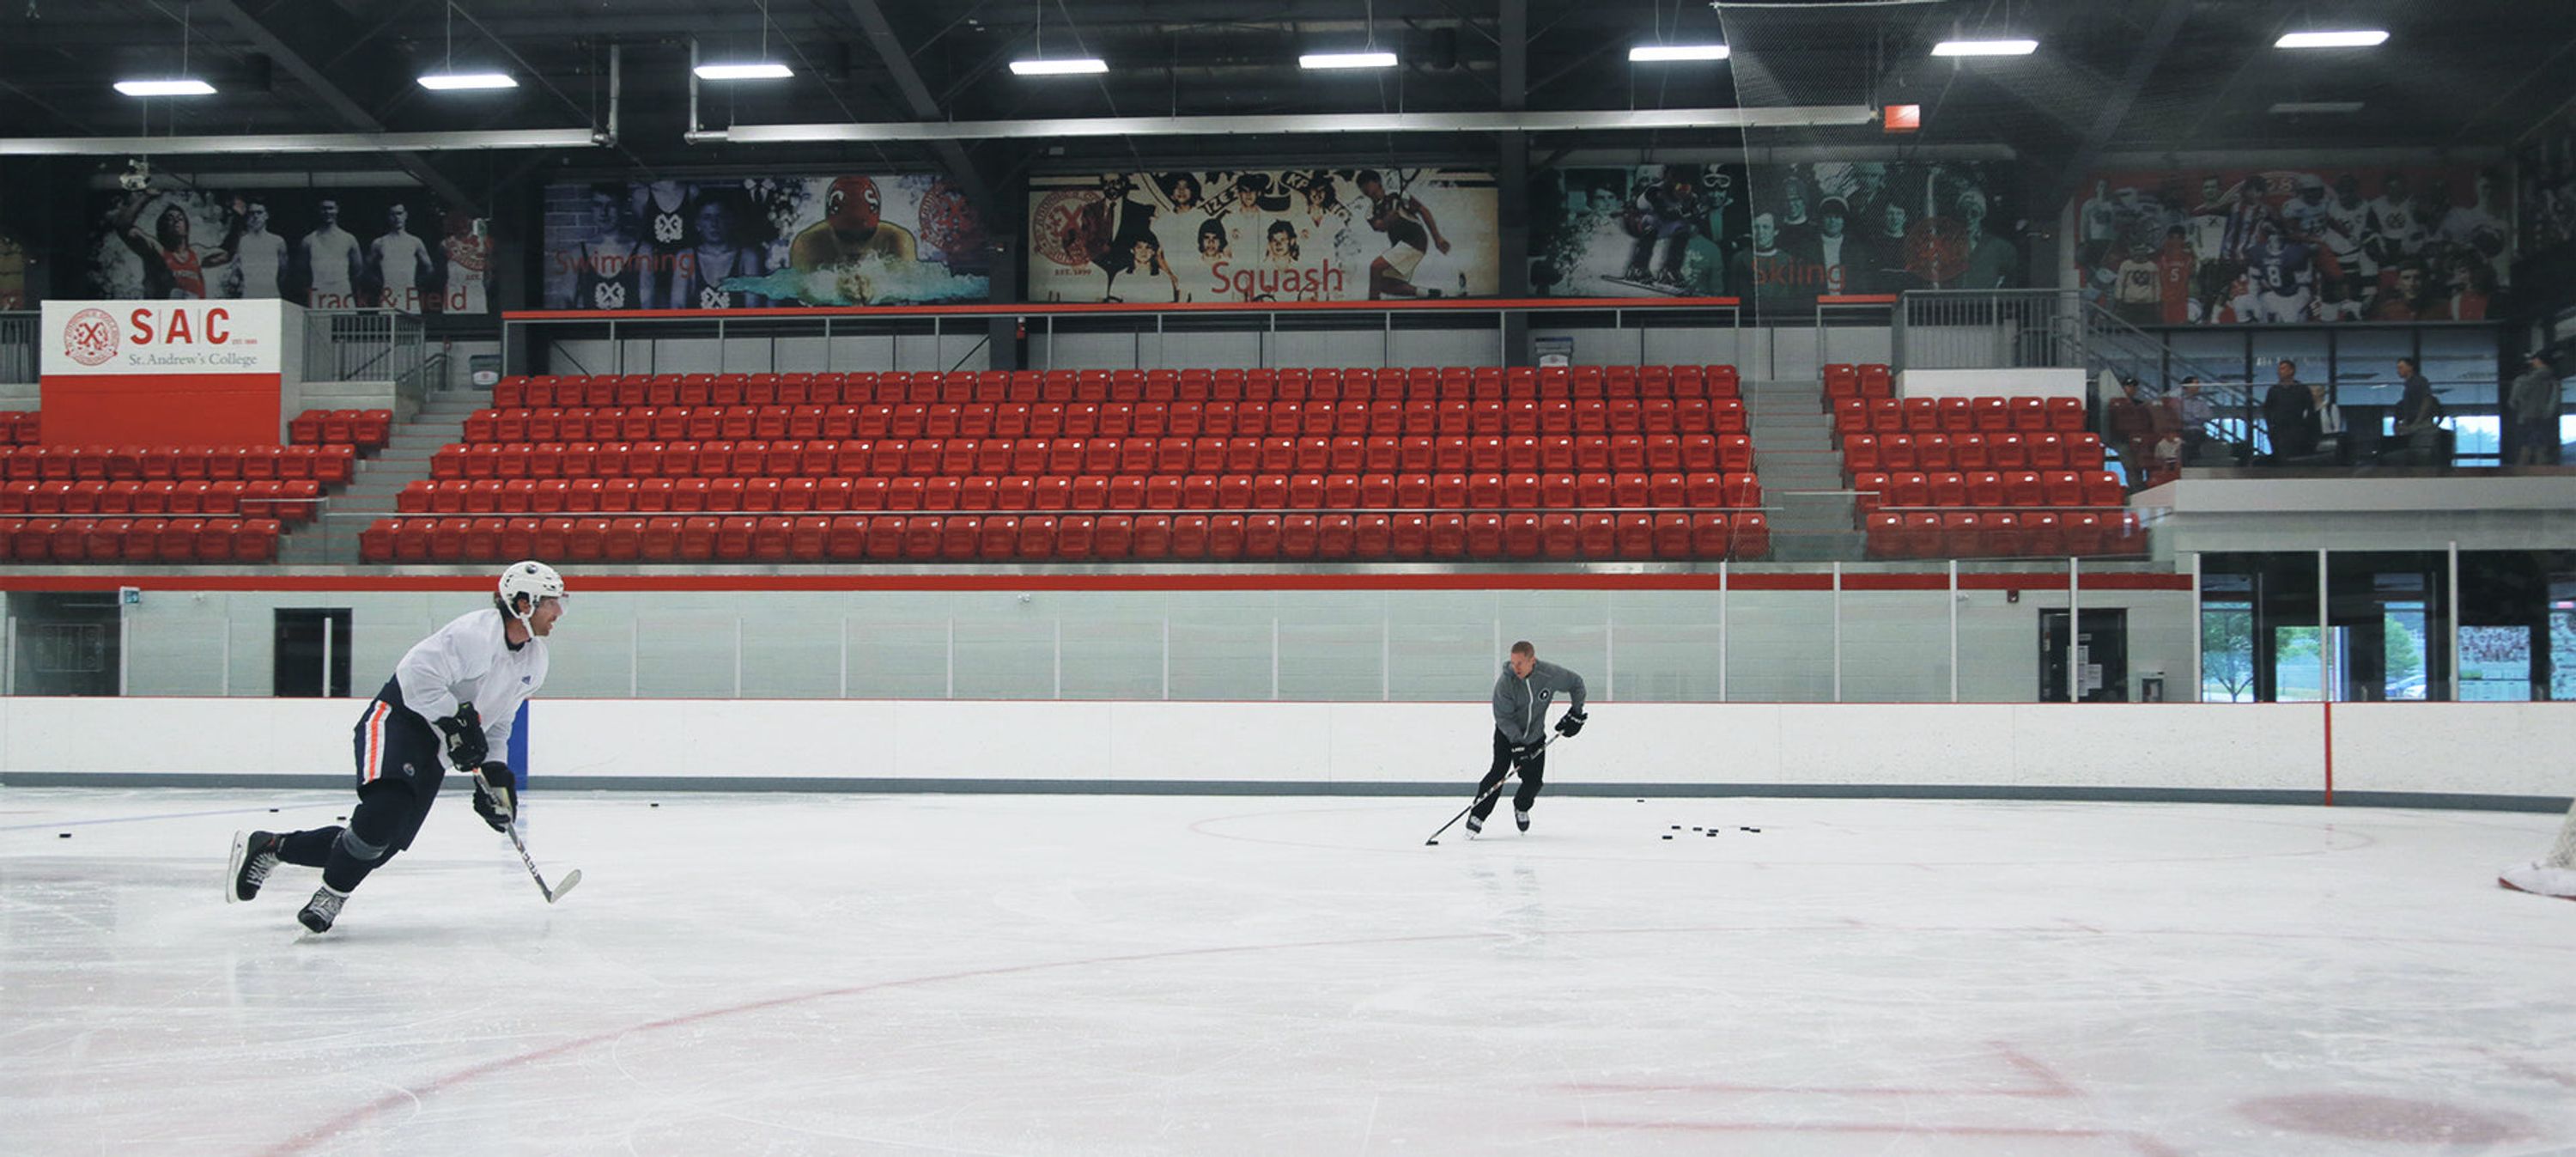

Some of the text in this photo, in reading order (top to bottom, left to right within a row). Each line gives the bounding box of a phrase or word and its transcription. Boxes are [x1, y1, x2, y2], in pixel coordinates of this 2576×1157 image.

[554, 248, 696, 278] Swimming
[1211, 258, 1344, 297] Squash
[1750, 256, 1847, 293] Skiing
[380, 286, 398, 308] &
[405, 285, 467, 311] Field
[144, 353, 205, 366] Andrew's
[209, 352, 258, 368] College
